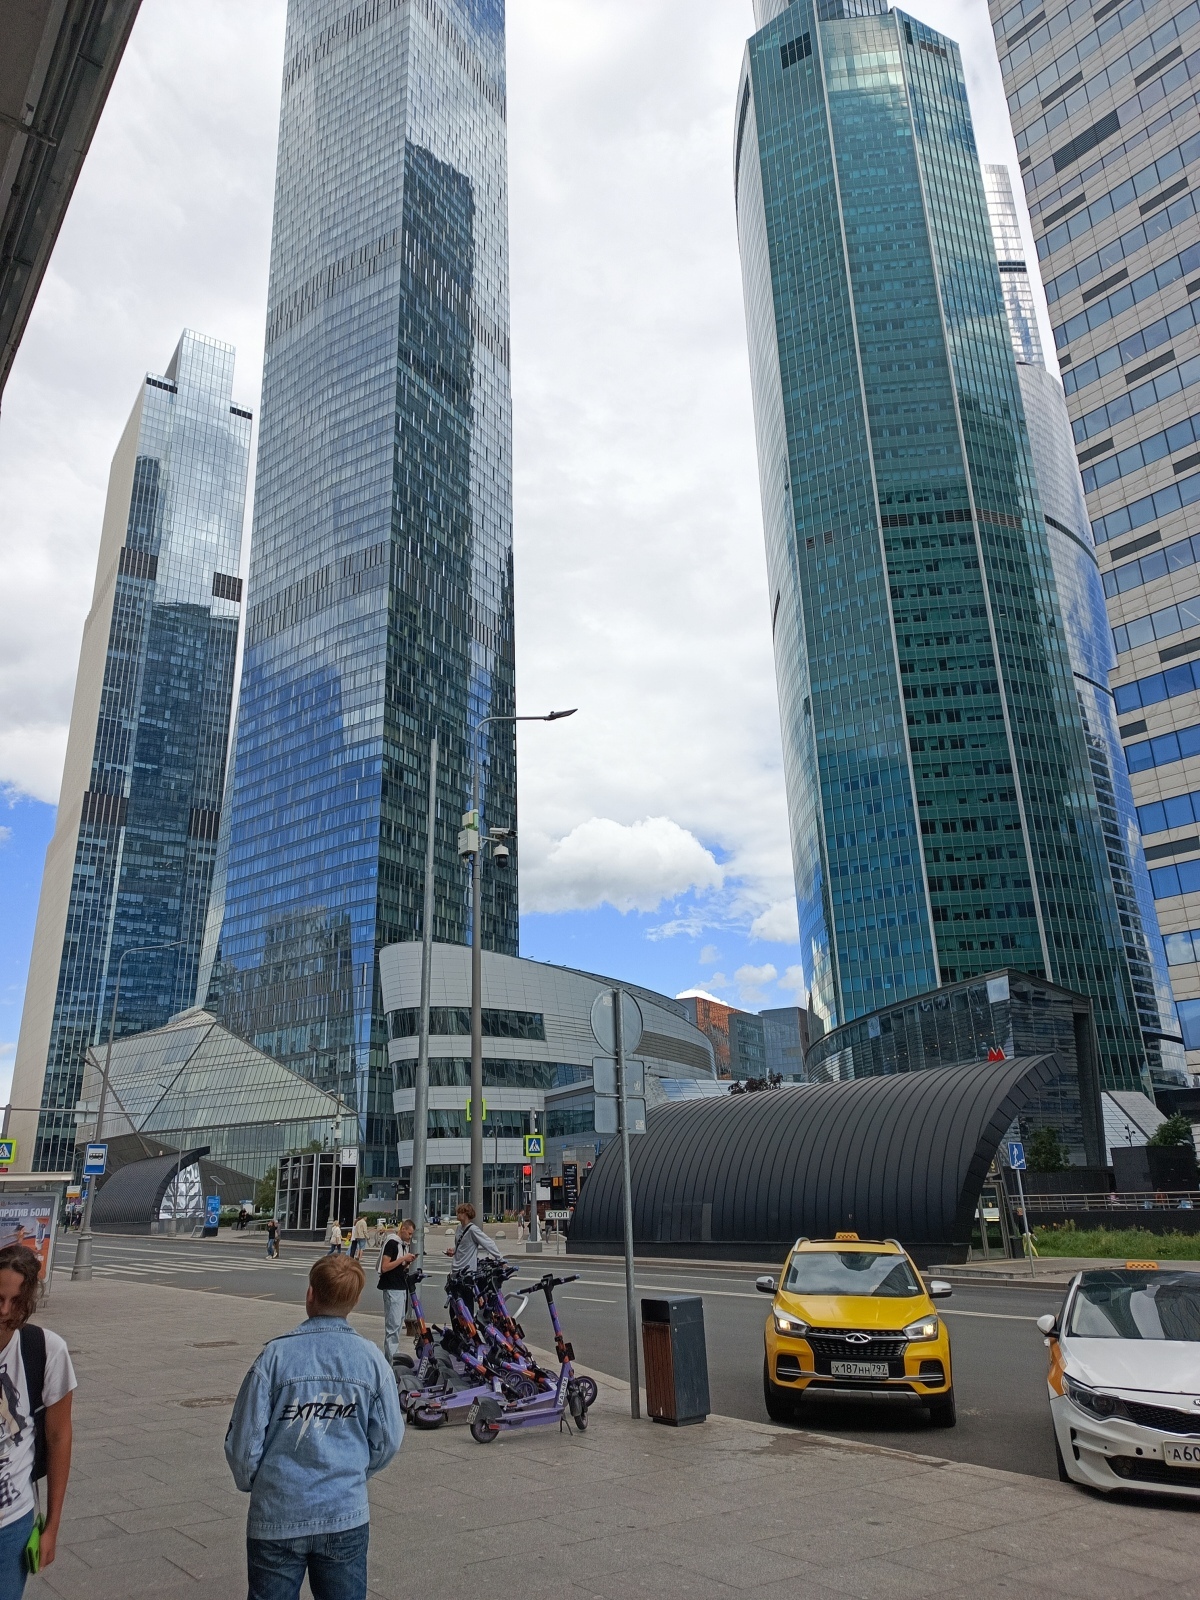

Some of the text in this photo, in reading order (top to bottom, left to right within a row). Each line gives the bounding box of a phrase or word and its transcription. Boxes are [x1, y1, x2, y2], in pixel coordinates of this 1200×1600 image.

[0, 1208, 50, 1217] ПРОТИВ БОЛИ
[872, 1364, 886, 1373] 797
[277, 1402, 358, 1421] EXTREME
